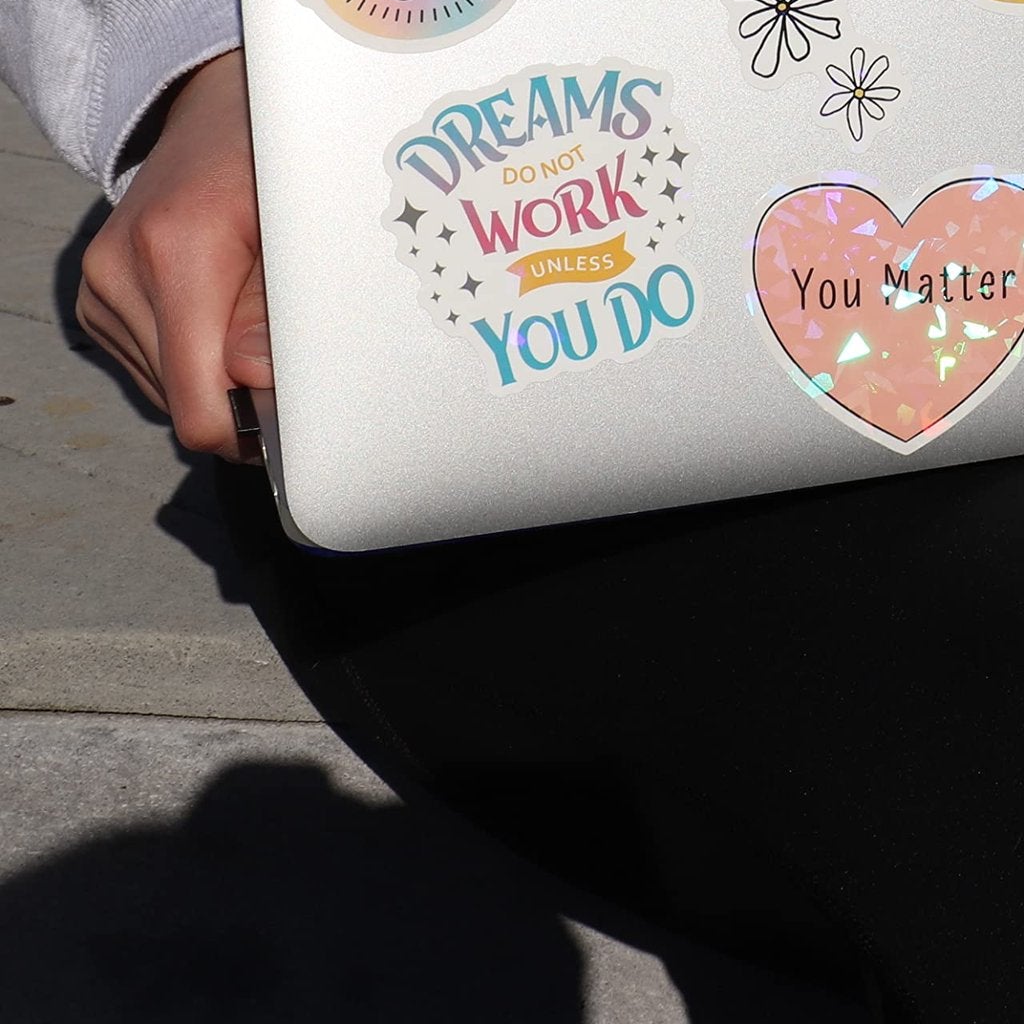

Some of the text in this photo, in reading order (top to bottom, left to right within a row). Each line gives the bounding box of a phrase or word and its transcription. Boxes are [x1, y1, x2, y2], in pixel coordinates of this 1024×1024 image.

[396, 70, 662, 196] DREAMS
[503, 144, 586, 185] DO NOT
[459, 149, 648, 256] WORK
[530, 253, 614, 278] UNLESS
[792, 264, 1016, 310] You Matter
[470, 263, 695, 386] YOU DO
